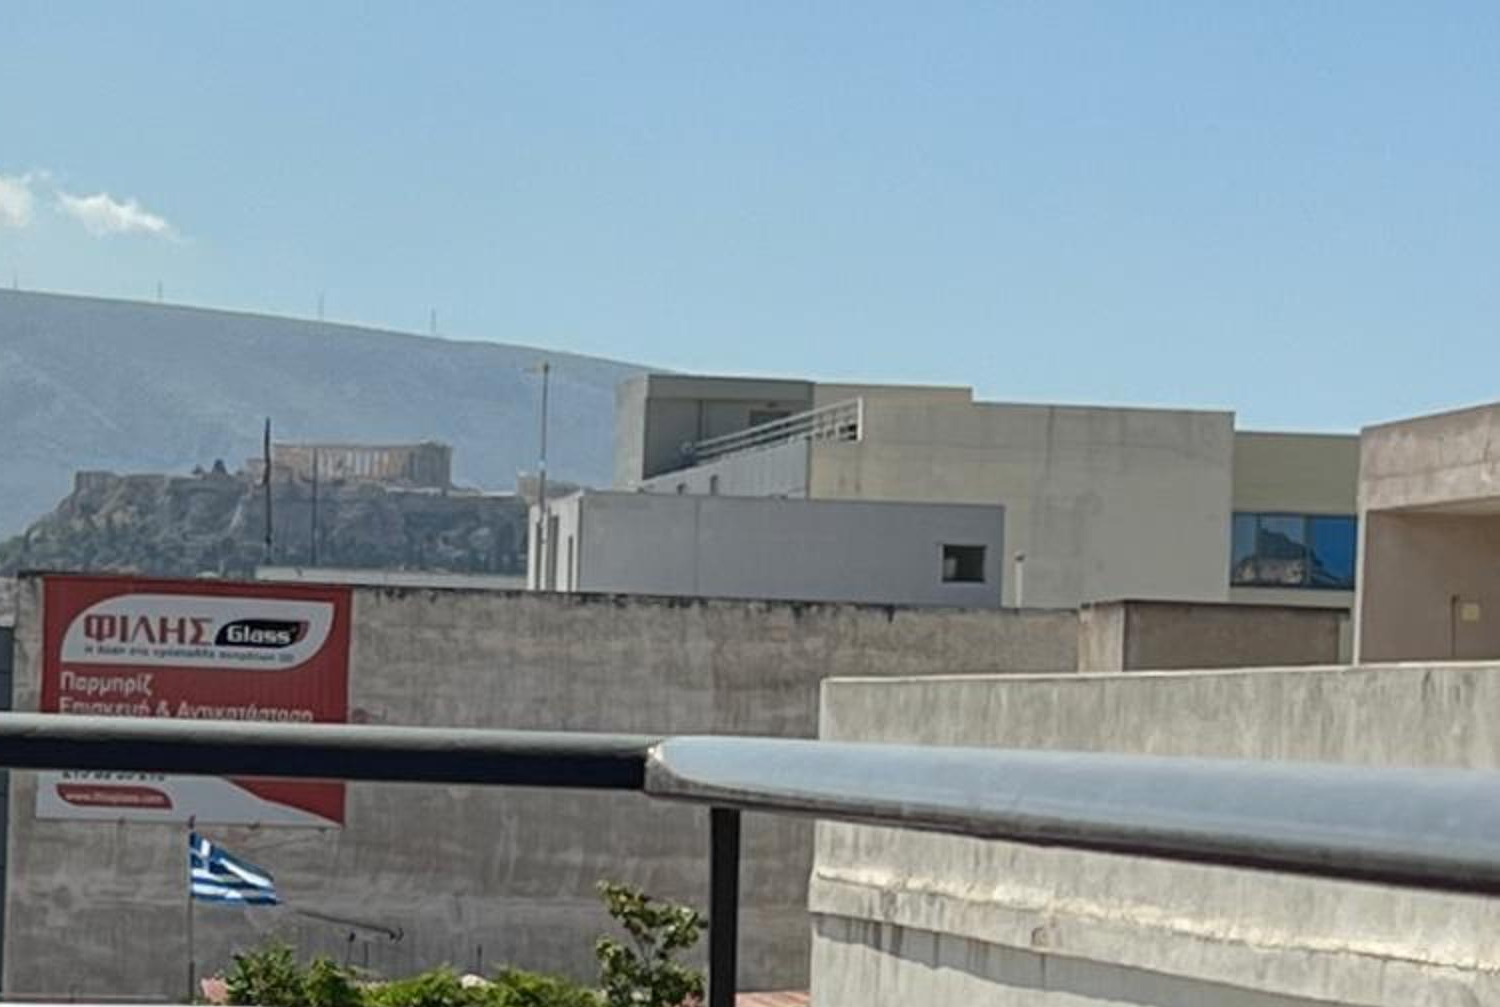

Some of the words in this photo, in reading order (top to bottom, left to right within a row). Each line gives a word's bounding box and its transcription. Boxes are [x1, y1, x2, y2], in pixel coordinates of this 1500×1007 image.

[84, 614, 213, 646] ΦΙΛΗΣ
[227, 624, 291, 644] Glass
[155, 700, 170, 718] &
